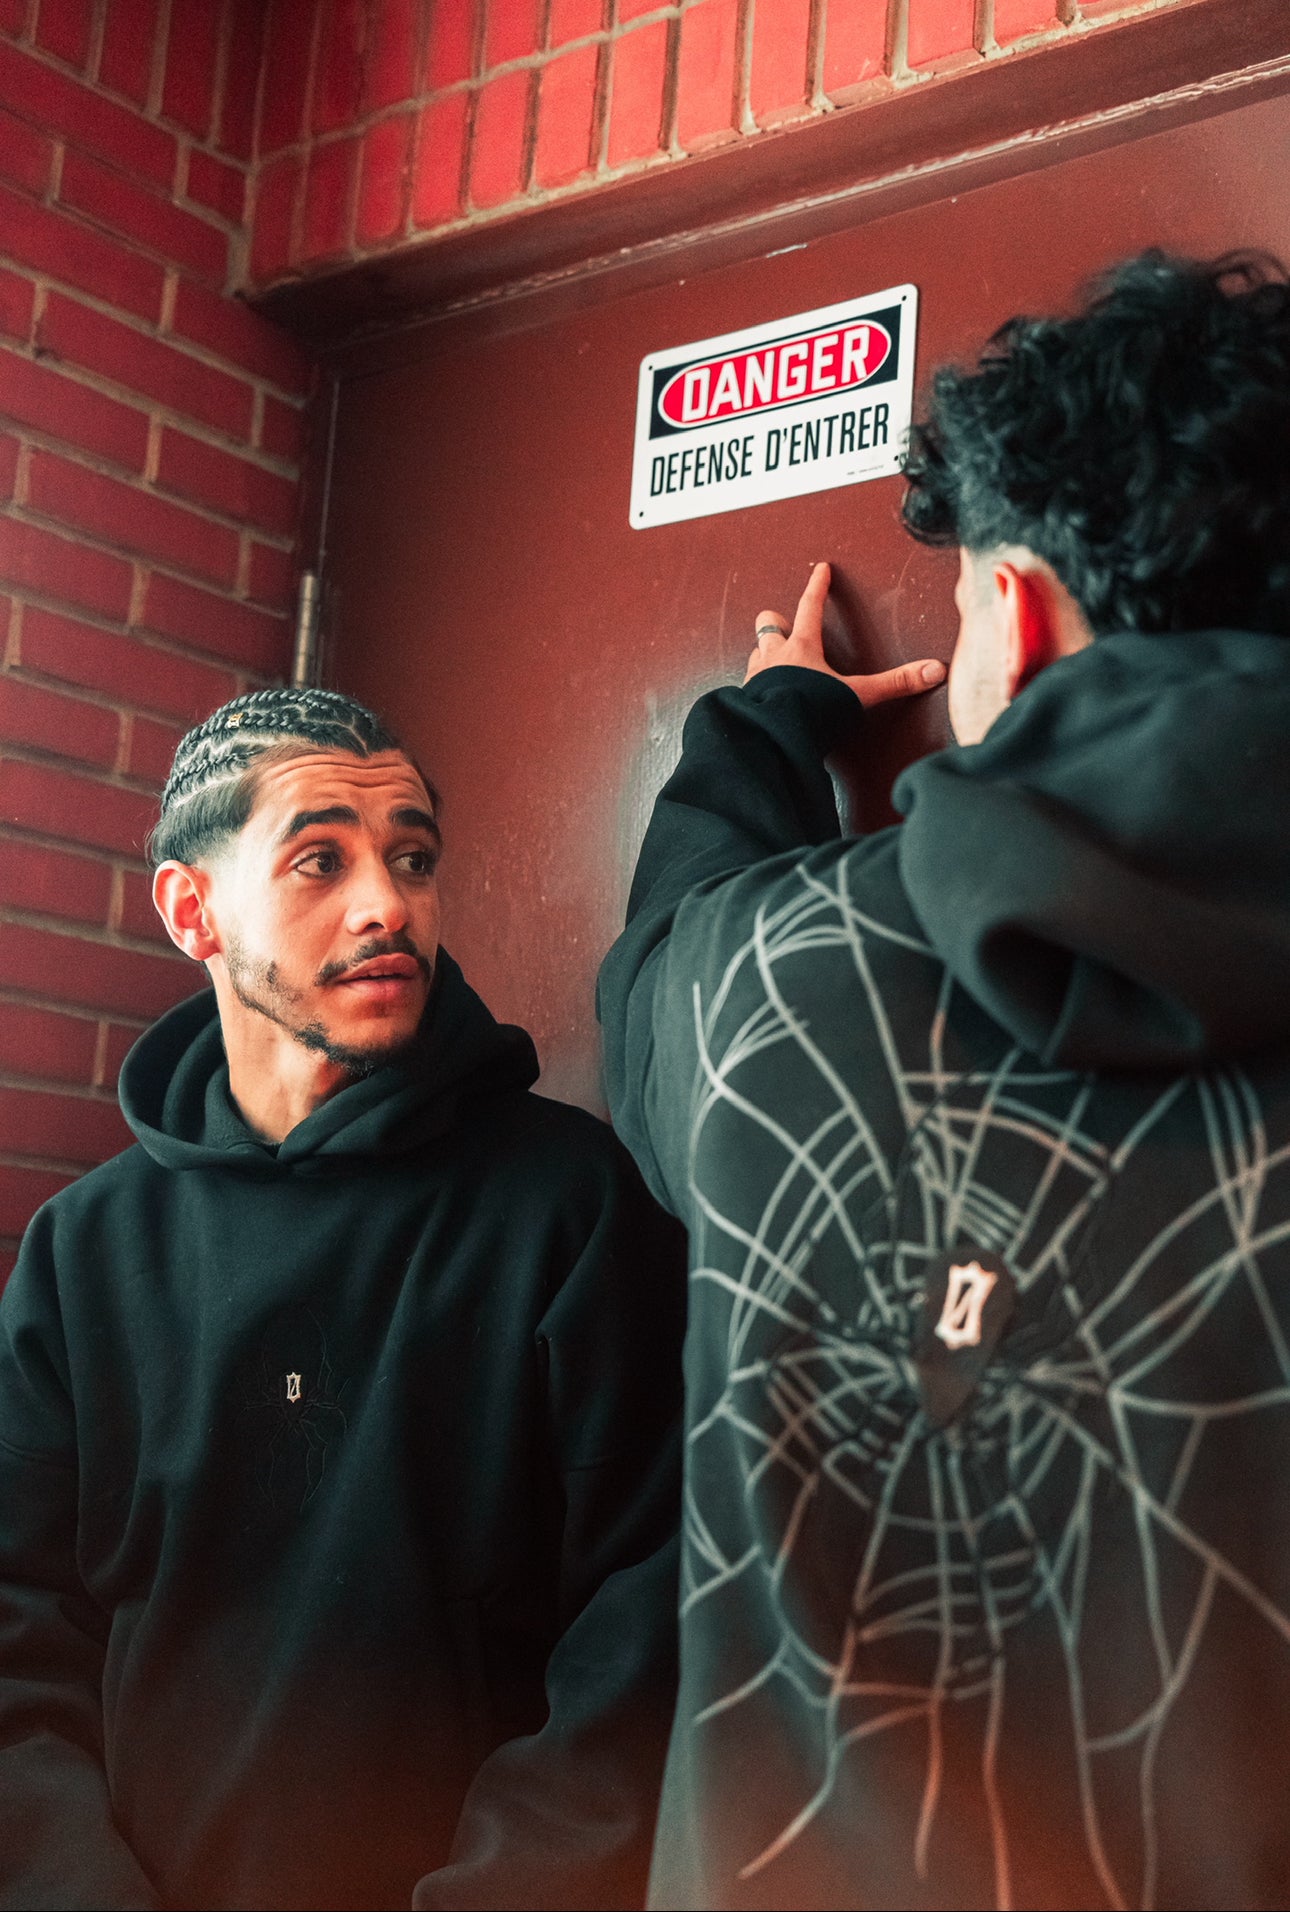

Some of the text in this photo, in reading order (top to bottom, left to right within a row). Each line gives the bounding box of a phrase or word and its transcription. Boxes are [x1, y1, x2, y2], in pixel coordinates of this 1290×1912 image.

[682, 326, 871, 422] DANGER
[650, 403, 889, 497] DEFENSE D'ENTRER
